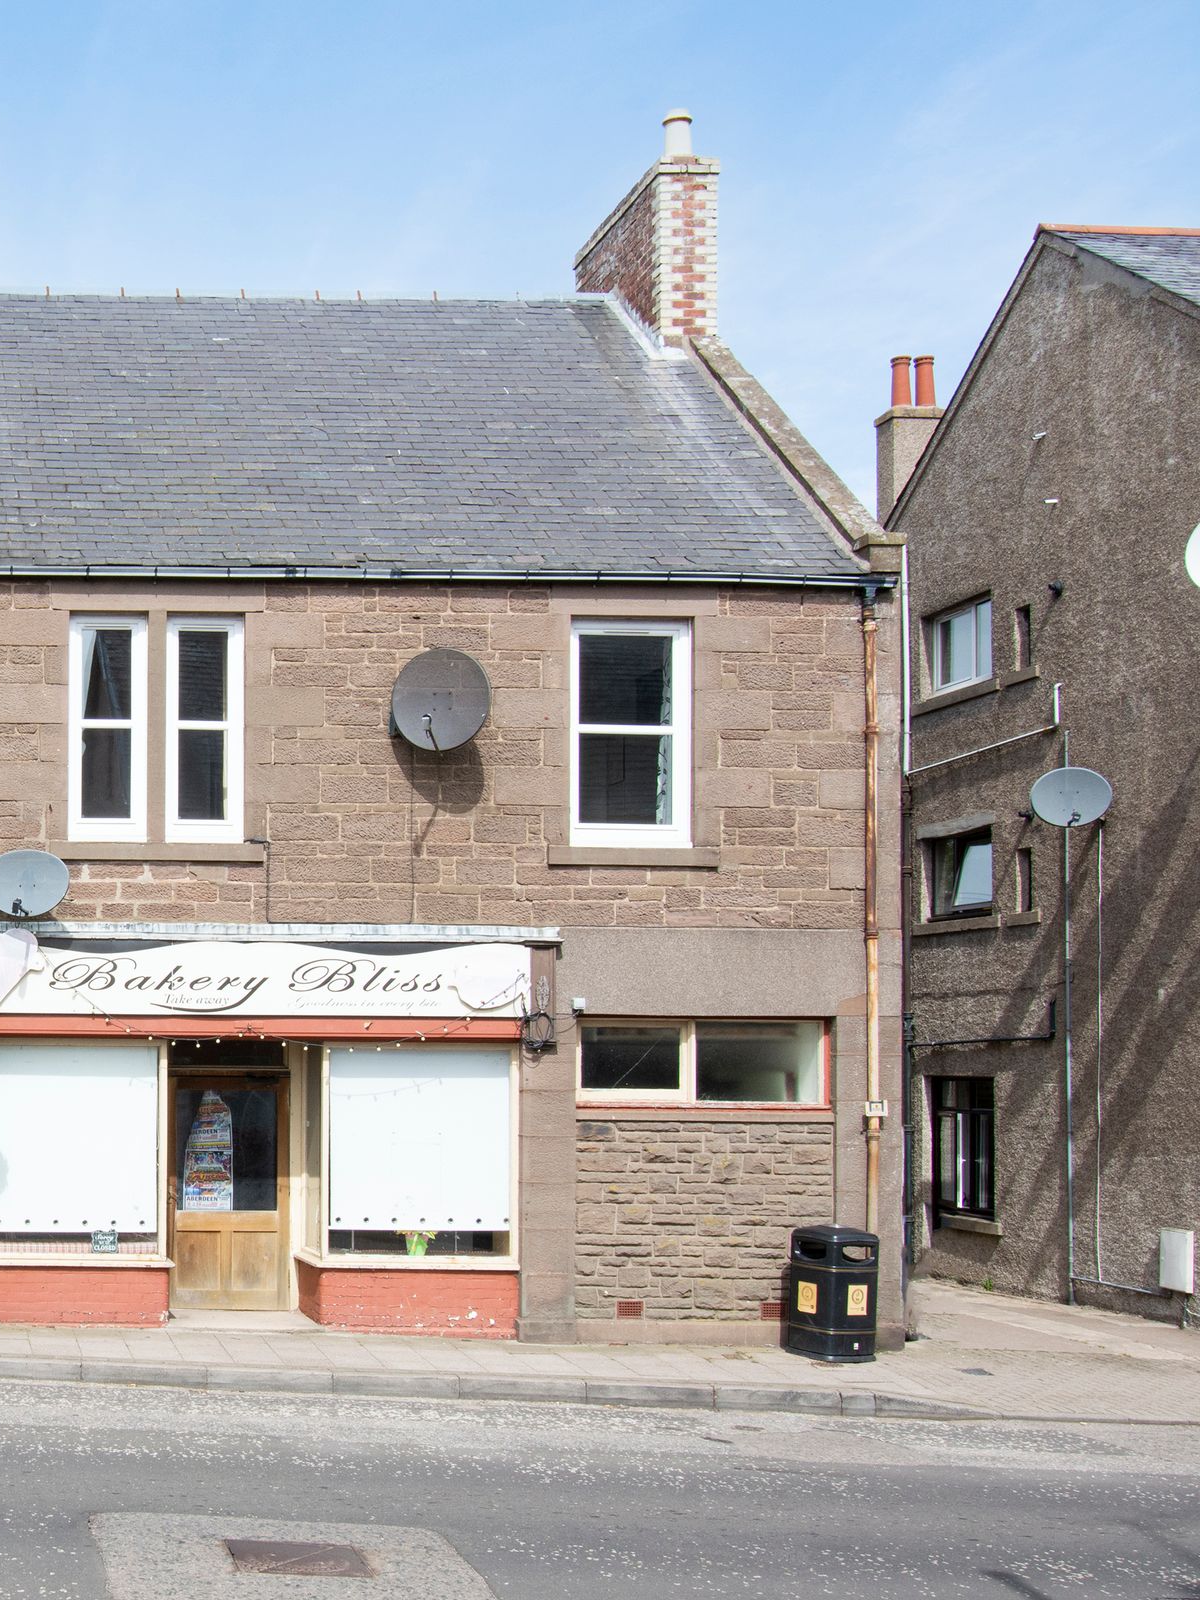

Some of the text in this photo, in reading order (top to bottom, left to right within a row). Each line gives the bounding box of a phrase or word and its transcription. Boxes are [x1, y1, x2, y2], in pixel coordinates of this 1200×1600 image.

[48, 957, 443, 1012] Bakery Bliss
[164, 993, 230, 1007] Take away
[291, 995, 442, 1010] Goodness in every bite
